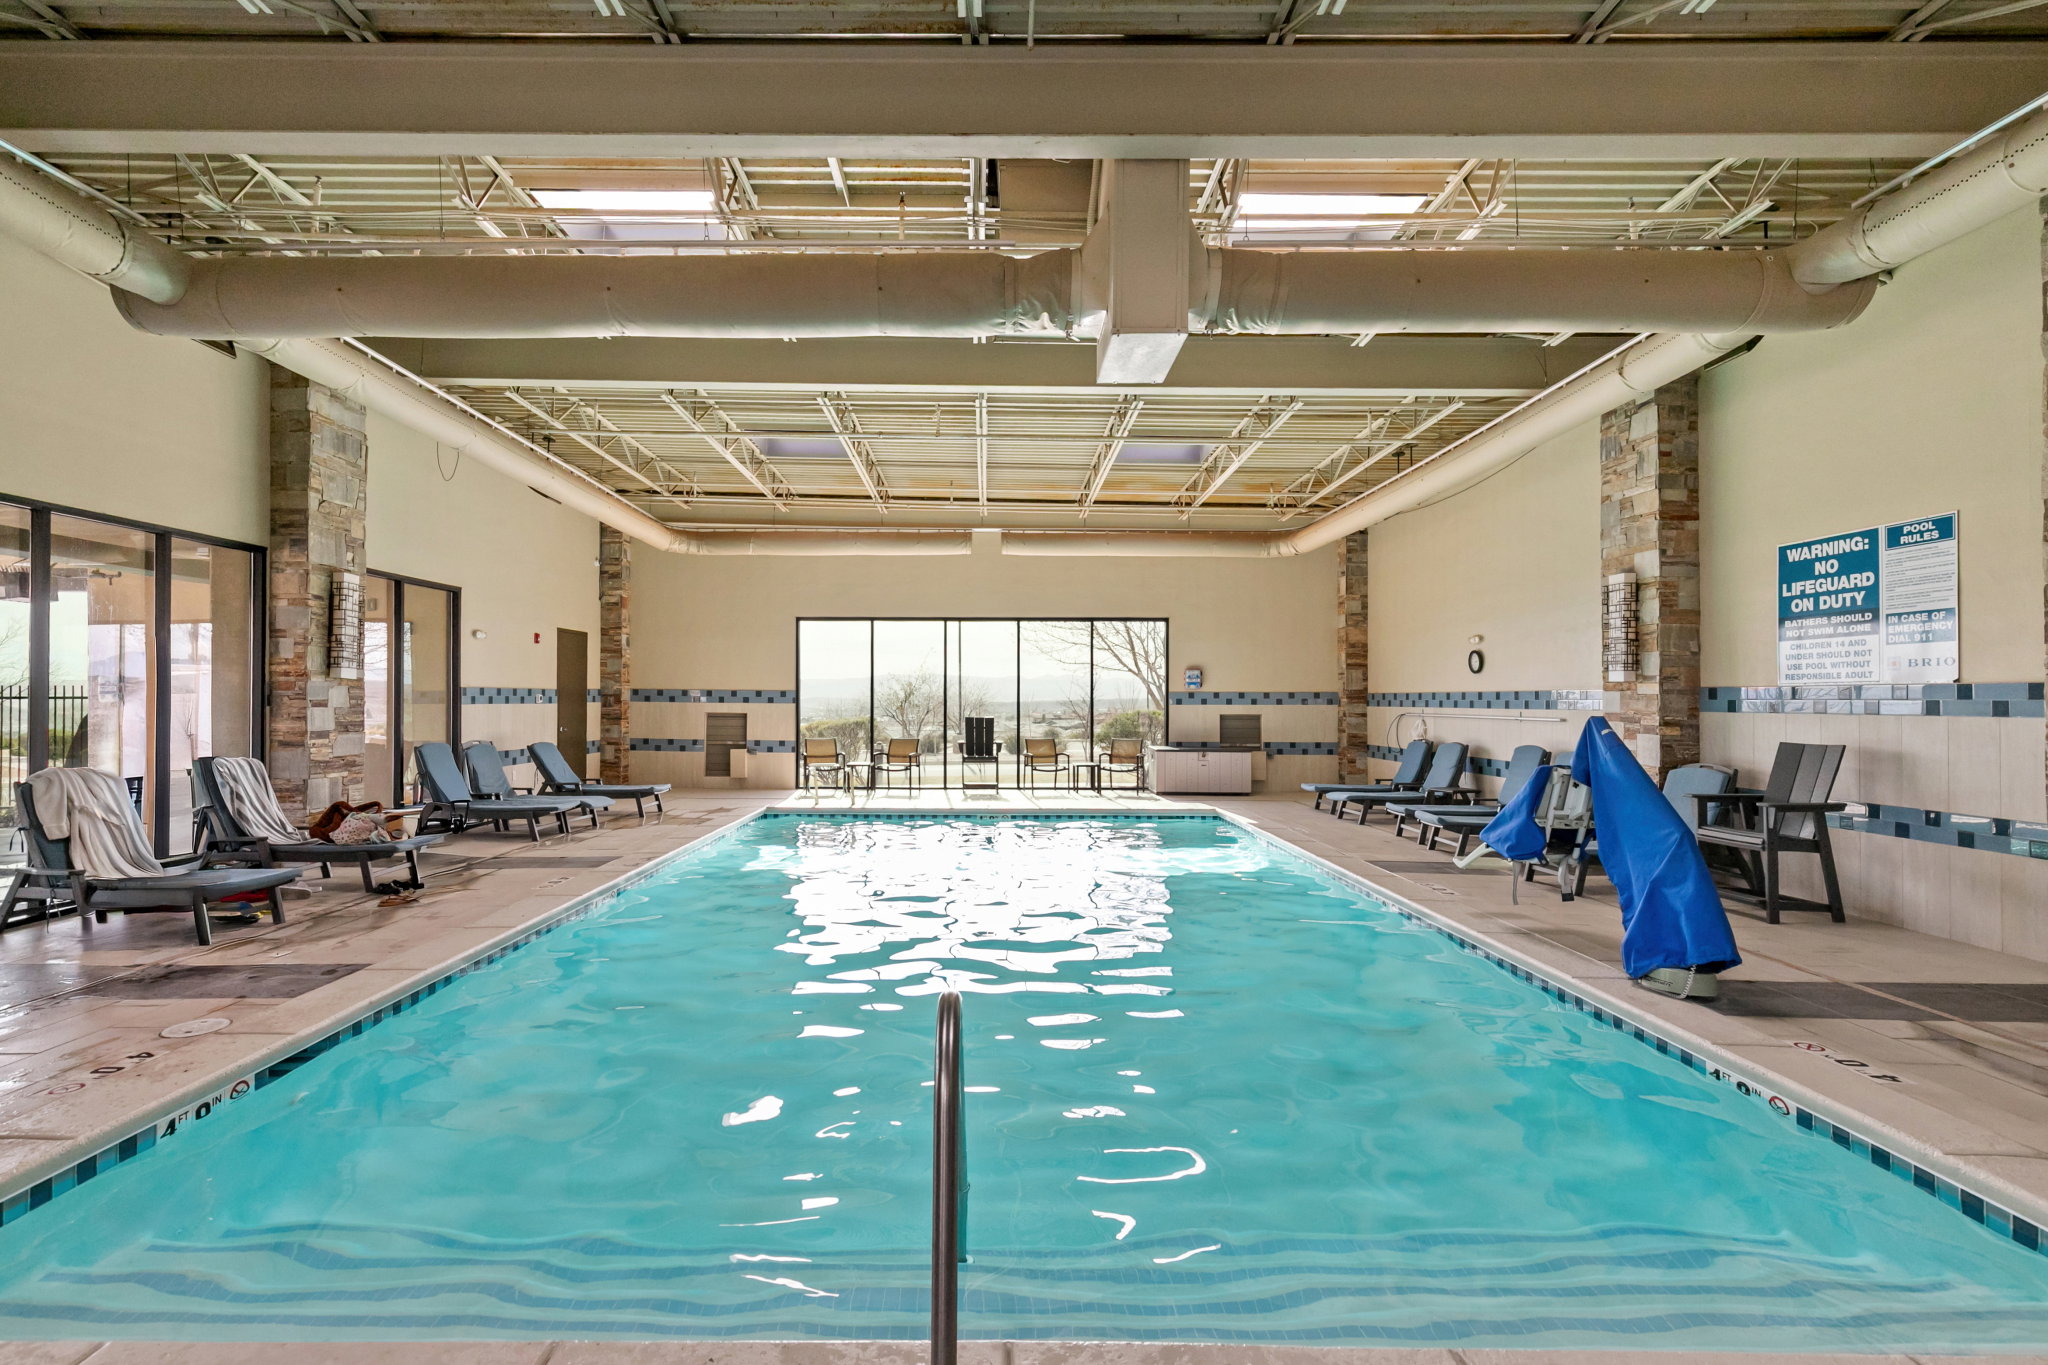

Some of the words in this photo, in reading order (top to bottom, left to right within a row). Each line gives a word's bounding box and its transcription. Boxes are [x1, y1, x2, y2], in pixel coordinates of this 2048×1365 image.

[1903, 521, 1936, 534] POOL
[1900, 530, 1940, 544] RULES
[1786, 536, 1869, 563] WARNING:
[1814, 559, 1839, 575] NO
[1782, 571, 1875, 597] LIFEGUARD
[1791, 597, 1814, 613] ON
[1819, 591, 1866, 610] DUTY
[1784, 617, 1828, 628] BATHERS
[1830, 613, 1872, 624] SHOULD
[1887, 615, 1898, 624] IN
[1901, 612, 1928, 623] CASE
[1931, 611, 1946, 620] OF
[1785, 629, 1805, 638] NOT
[1808, 627, 1834, 636] SWIM
[1836, 624, 1871, 634] ALONE
[1888, 620, 1953, 634] EMERGENCY
[1888, 634, 1911, 643] DIAL
[1914, 632, 1933, 642] 911
[1790, 641, 1832, 651] CHILDREN
[1835, 640, 1845, 648] 14
[1848, 639, 1867, 647] AND
[1785, 652, 1813, 661] UNDER
[1816, 650, 1851, 659] SHOULD
[1853, 649, 1872, 658] NOT
[1787, 663, 1803, 671] USE
[1805, 662, 1828, 670] POOL
[1830, 660, 1871, 669] WITHOUT
[1908, 656, 1956, 668] BRIO
[1785, 672, 1841, 681] RESPONSIBLE
[1845, 671, 1873, 679] ADULT
